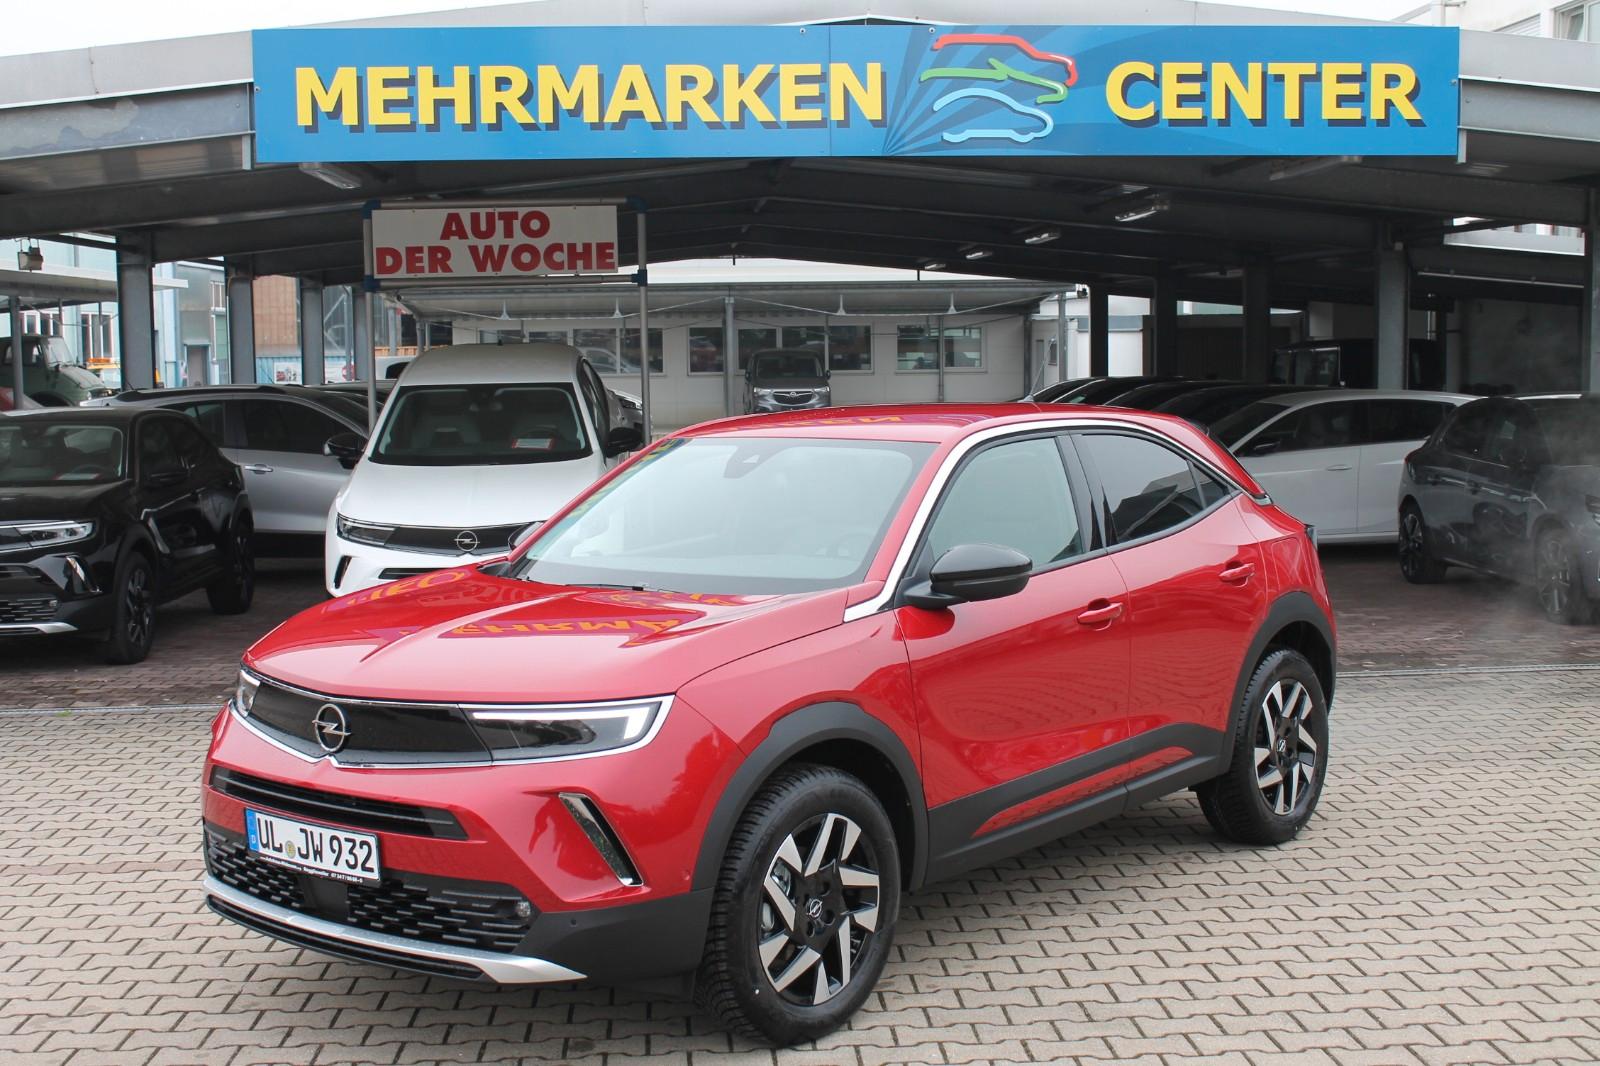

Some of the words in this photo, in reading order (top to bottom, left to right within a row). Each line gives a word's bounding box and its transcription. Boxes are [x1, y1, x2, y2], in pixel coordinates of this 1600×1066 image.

[295, 62, 884, 129] MEHRMARKEN
[1105, 61, 1423, 123] CENTER
[440, 210, 550, 240] AUTO
[375, 246, 453, 275] DER
[467, 242, 615, 273] WOCHE
[257, 817, 283, 853] UL
[298, 828, 324, 863] JW
[329, 834, 375, 873] 932
